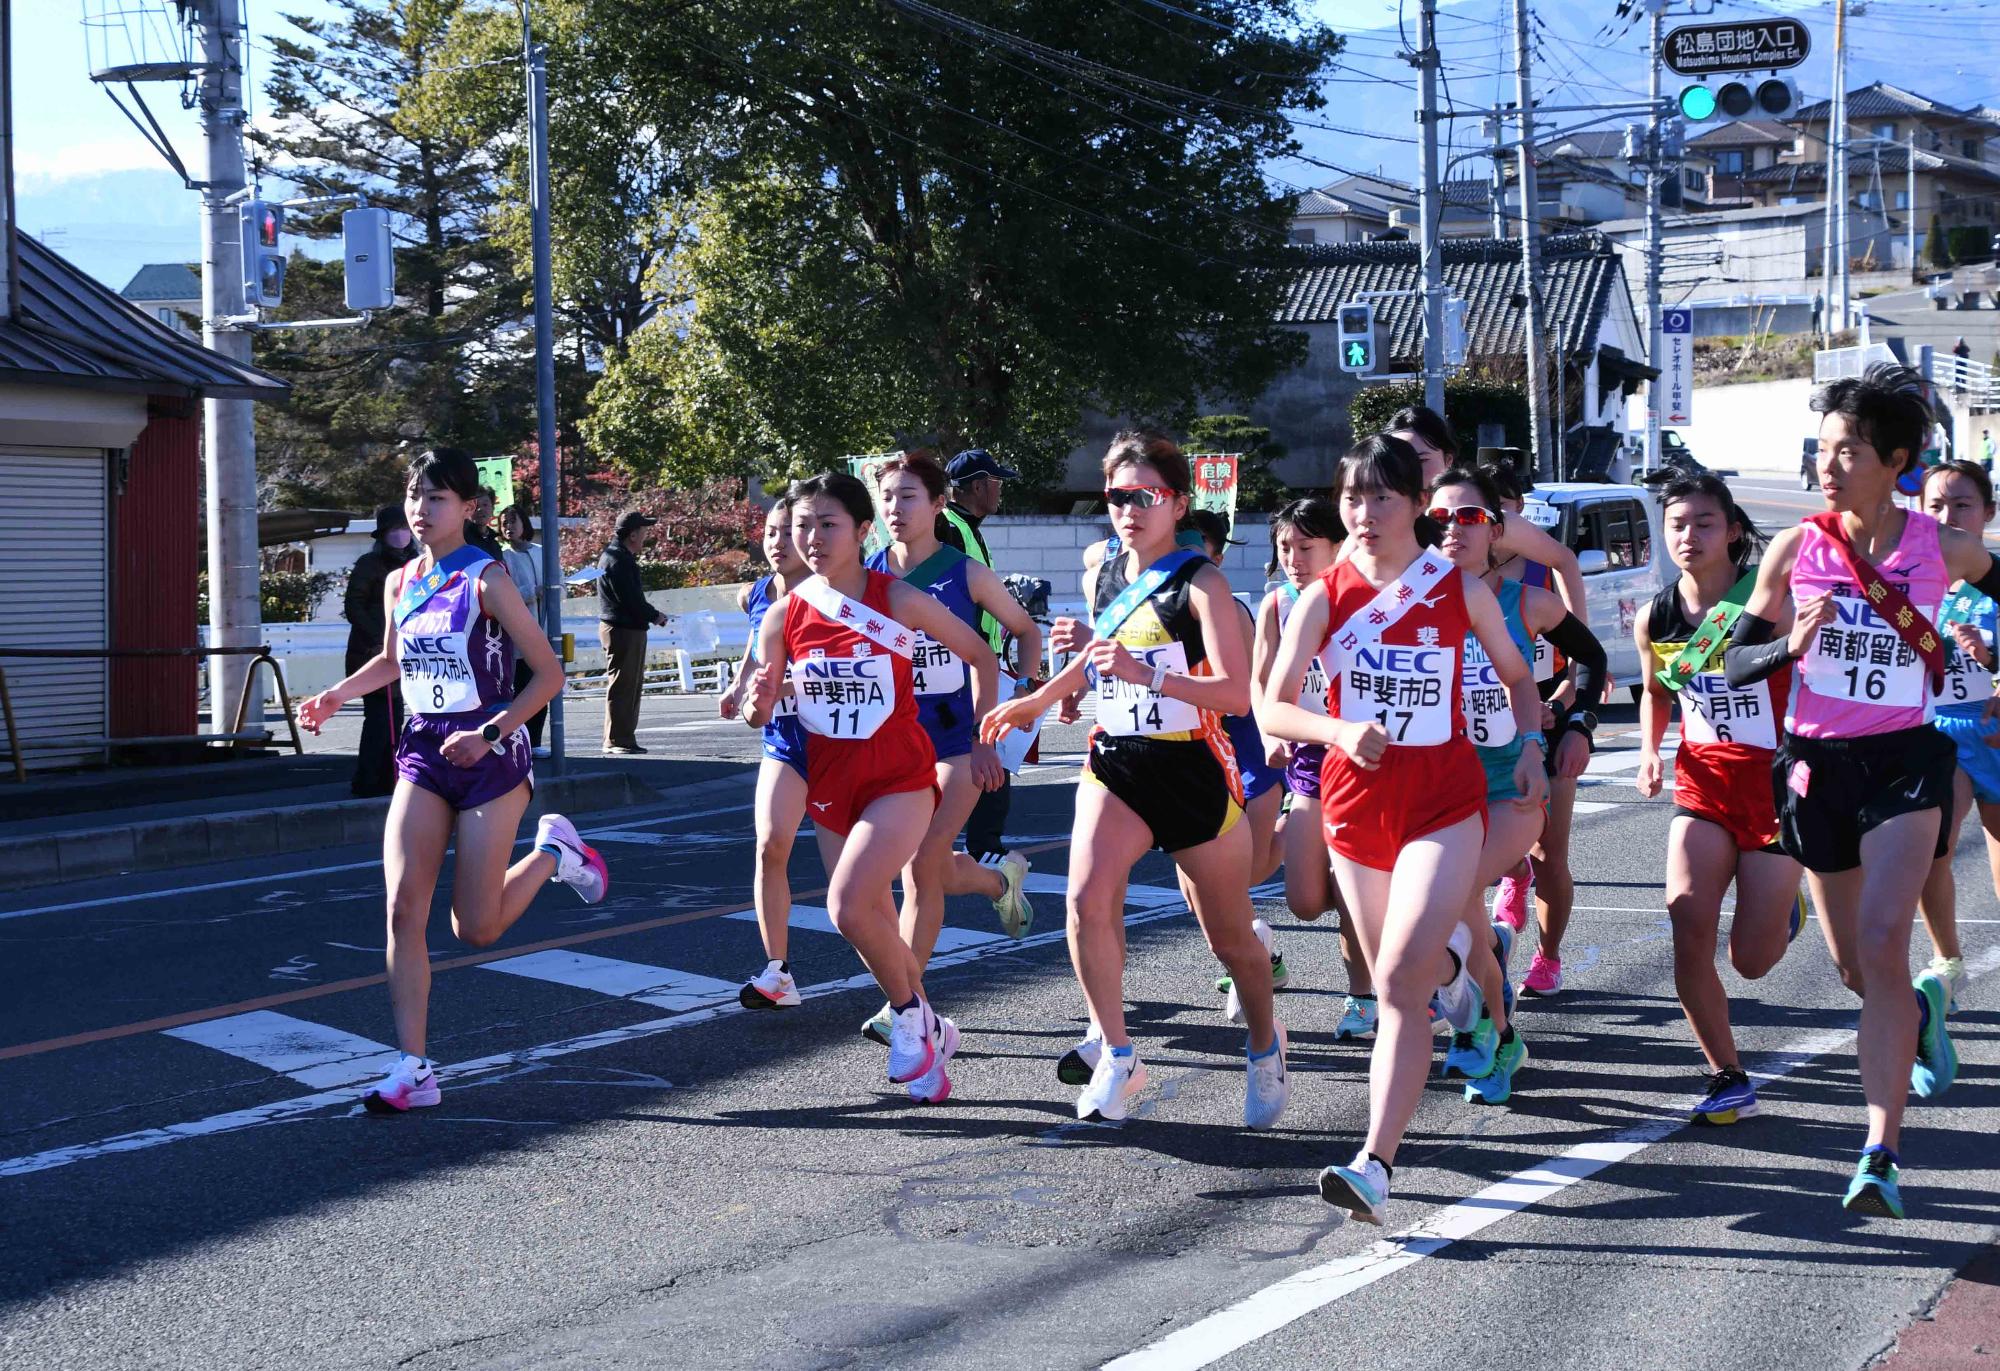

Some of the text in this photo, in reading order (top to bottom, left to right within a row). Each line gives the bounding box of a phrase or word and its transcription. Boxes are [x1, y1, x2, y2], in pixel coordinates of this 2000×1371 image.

[1676, 26, 1795, 55] 松島団地入口
[1676, 54, 1720, 67] Matsushima
[1721, 51, 1751, 65] Housing
[1753, 47, 1785, 62] Complex
[1200, 462, 1231, 479] 危険
[1208, 480, 1225, 489] です
[1339, 562, 1438, 651] 甲斐市B
[839, 604, 907, 648] 甲斐市
[403, 636, 455, 654] NEC
[1678, 612, 1727, 675] 大月市
[1819, 627, 1917, 667] 南都留郡
[401, 656, 471, 680] 南アルプス市A
[805, 660, 878, 679] NEC
[1356, 648, 1440, 674] NEC
[804, 681, 885, 706] 甲斐市A
[913, 670, 927, 692] 4
[1351, 671, 1441, 707] 甲斐市B
[1845, 666, 1886, 700] 16
[1952, 678, 1967, 700] 5
[432, 684, 445, 708] 8
[1687, 694, 1760, 720] 大月市
[829, 708, 860, 736] 11
[1129, 703, 1163, 731] 14
[1375, 709, 1413, 742] 17
[1716, 724, 1732, 743] 6
